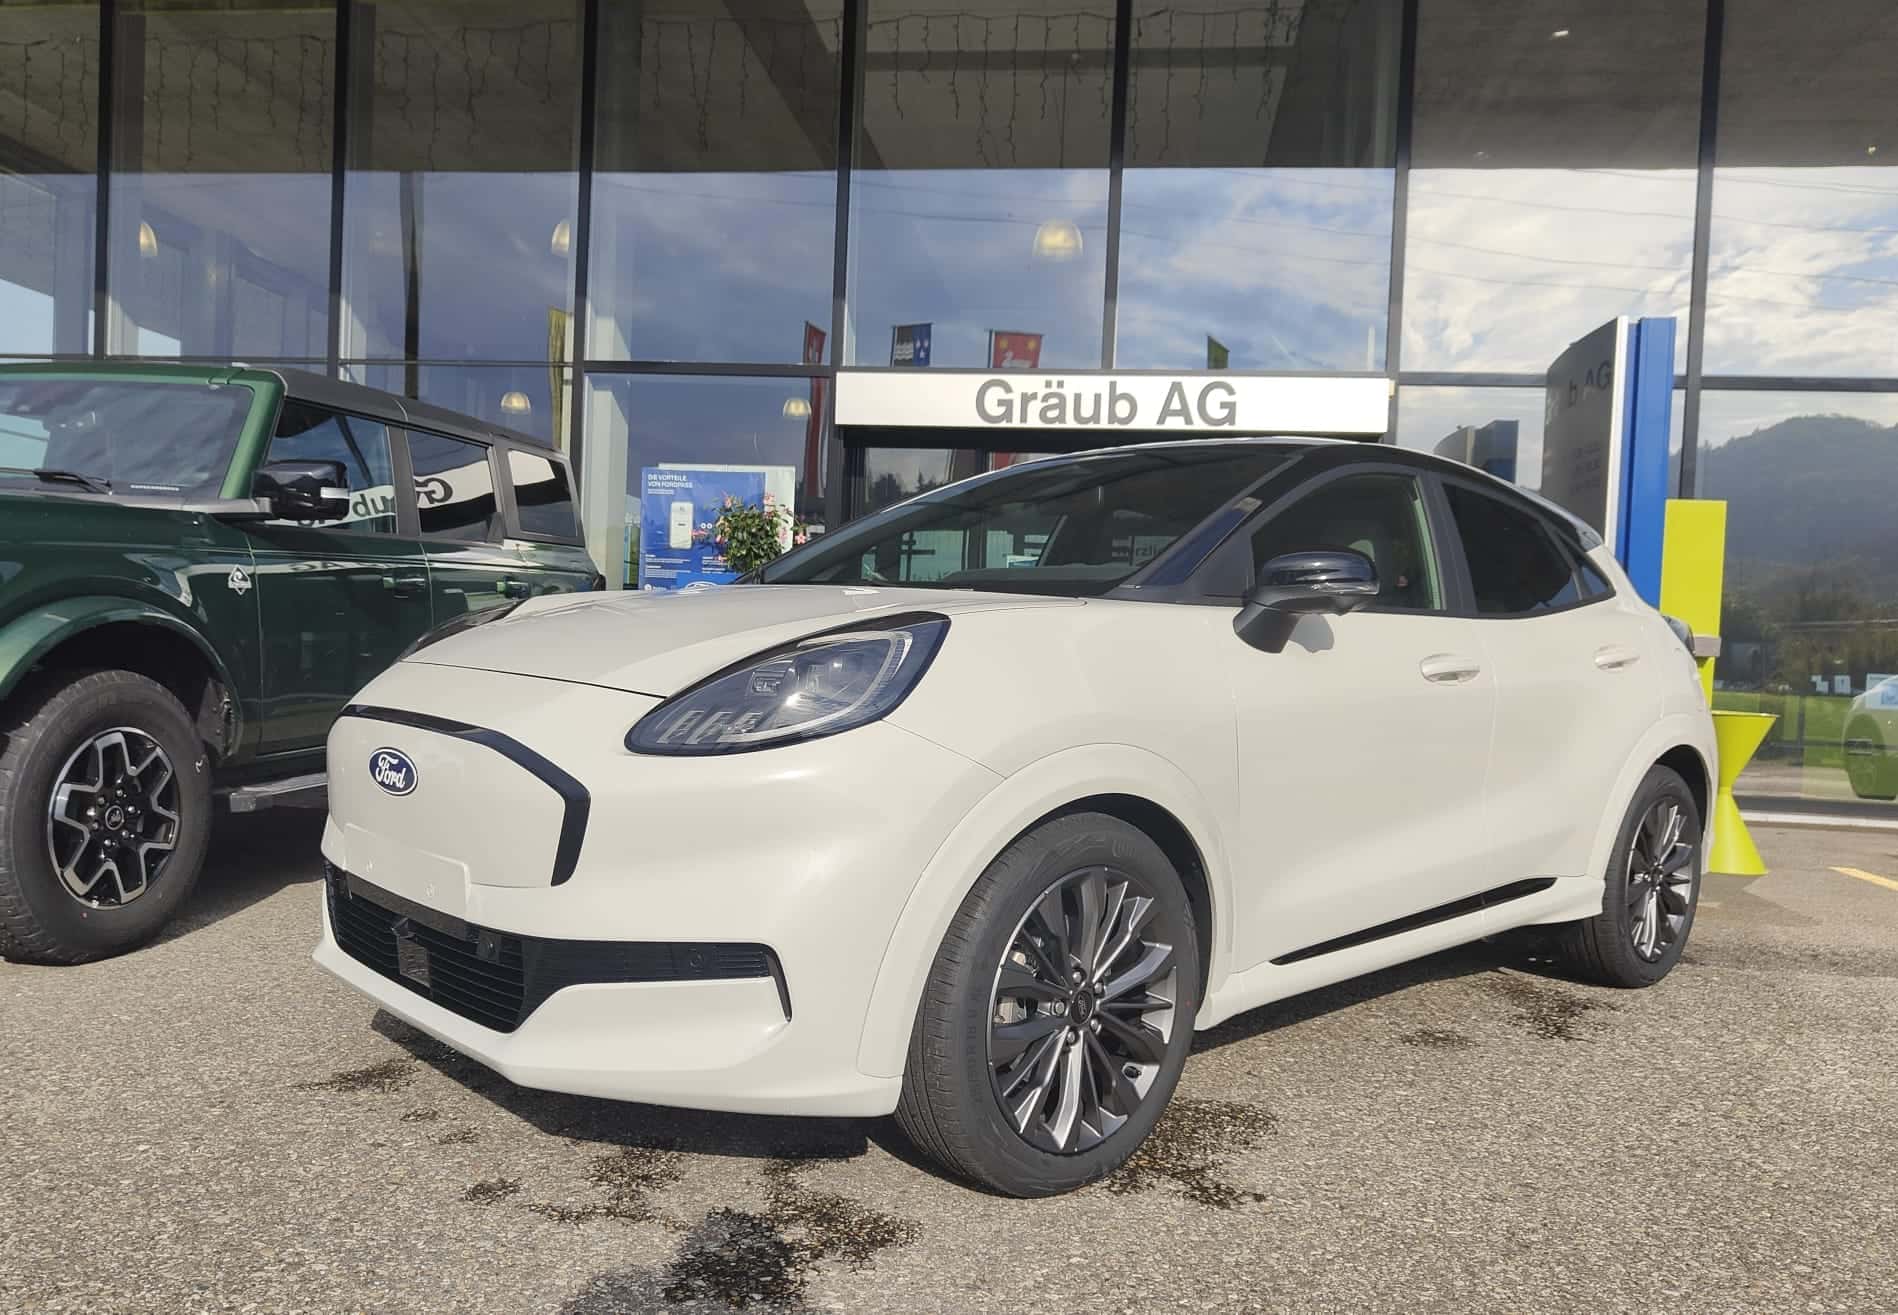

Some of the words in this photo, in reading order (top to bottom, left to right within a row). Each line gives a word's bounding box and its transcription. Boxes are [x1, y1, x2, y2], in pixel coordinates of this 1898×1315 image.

[975, 378, 1138, 425] Gräub
[1156, 381, 1237, 426] AG
[376, 754, 407, 788] Ford
